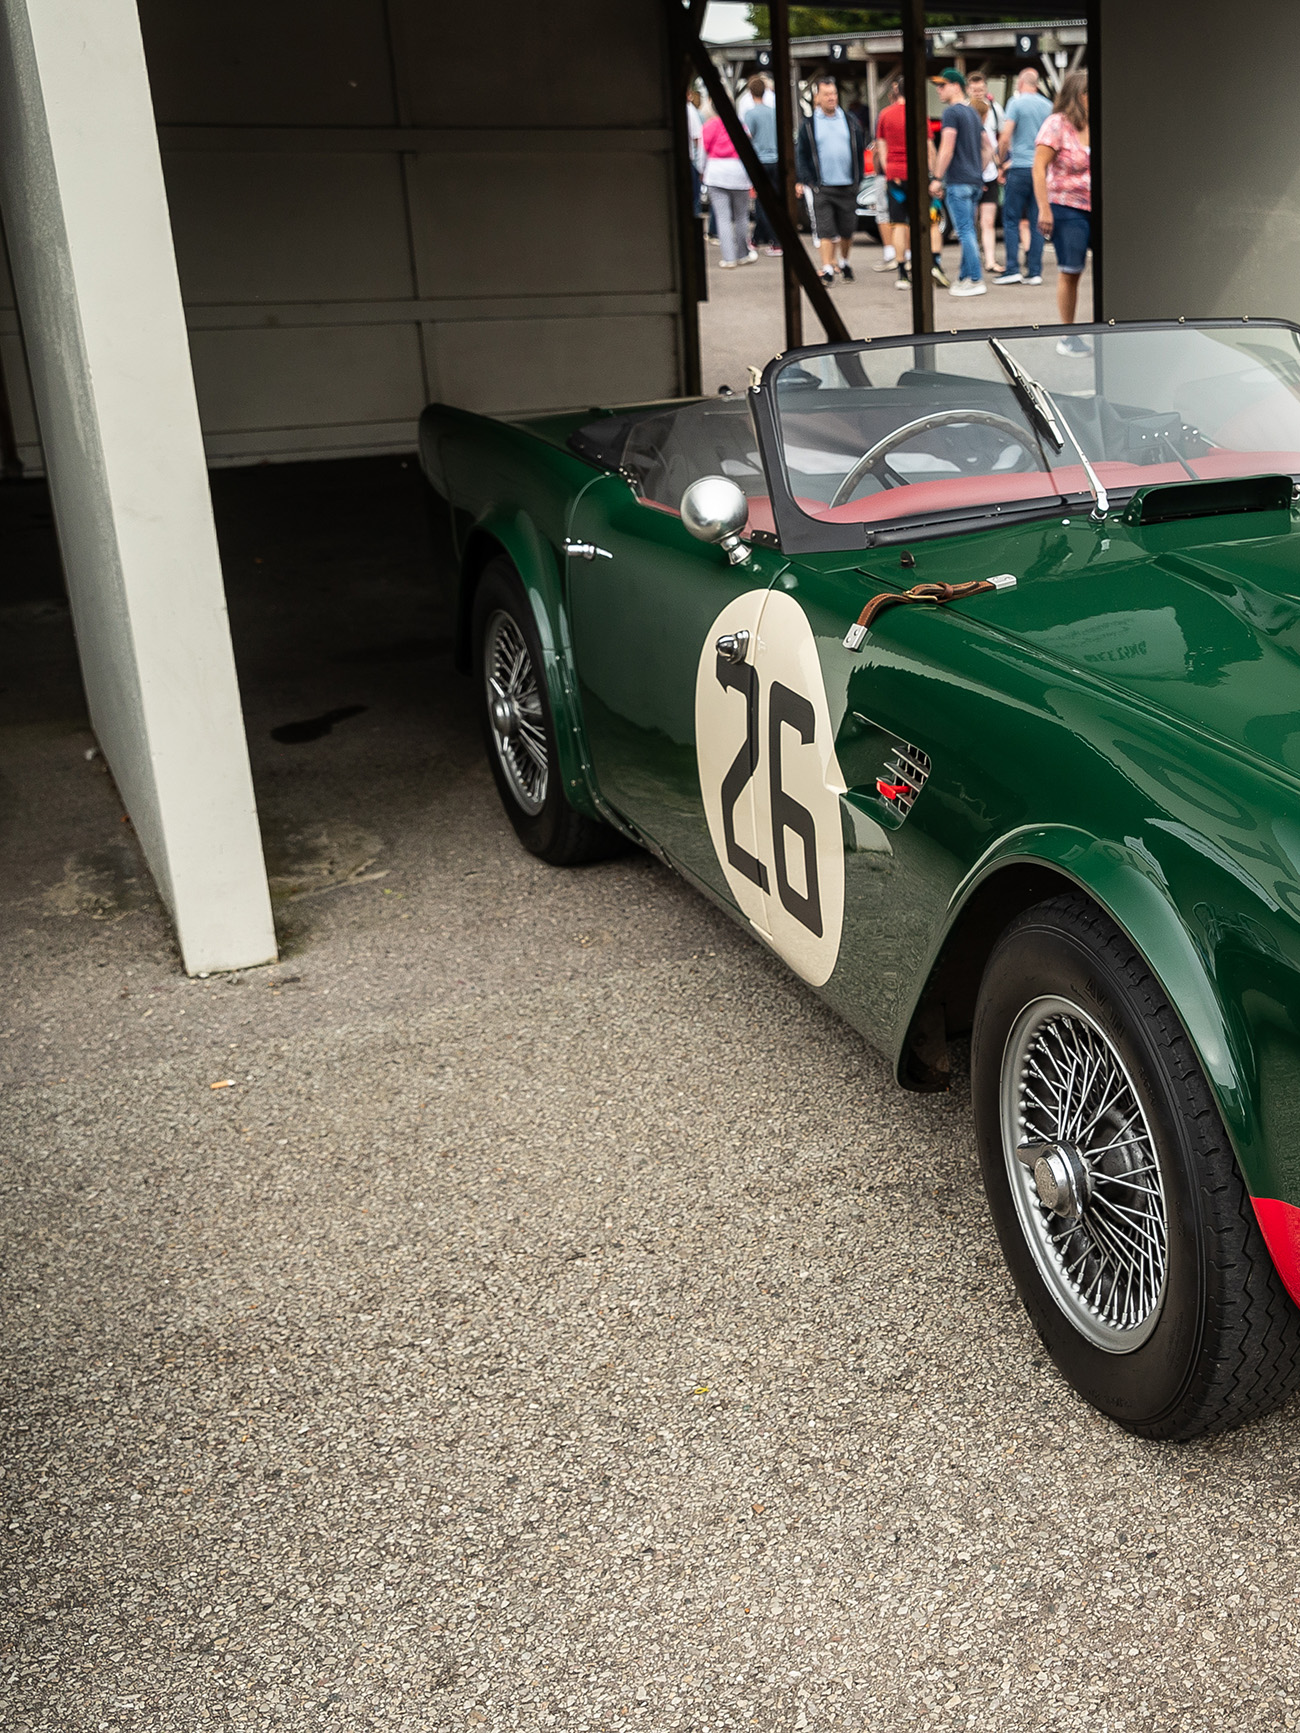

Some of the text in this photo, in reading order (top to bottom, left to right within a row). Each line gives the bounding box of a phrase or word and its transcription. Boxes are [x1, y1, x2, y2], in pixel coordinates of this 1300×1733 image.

[832, 44, 842, 59] 7
[1020, 36, 1031, 52] 9
[759, 52, 770, 65] 6
[716, 650, 823, 938] 26
